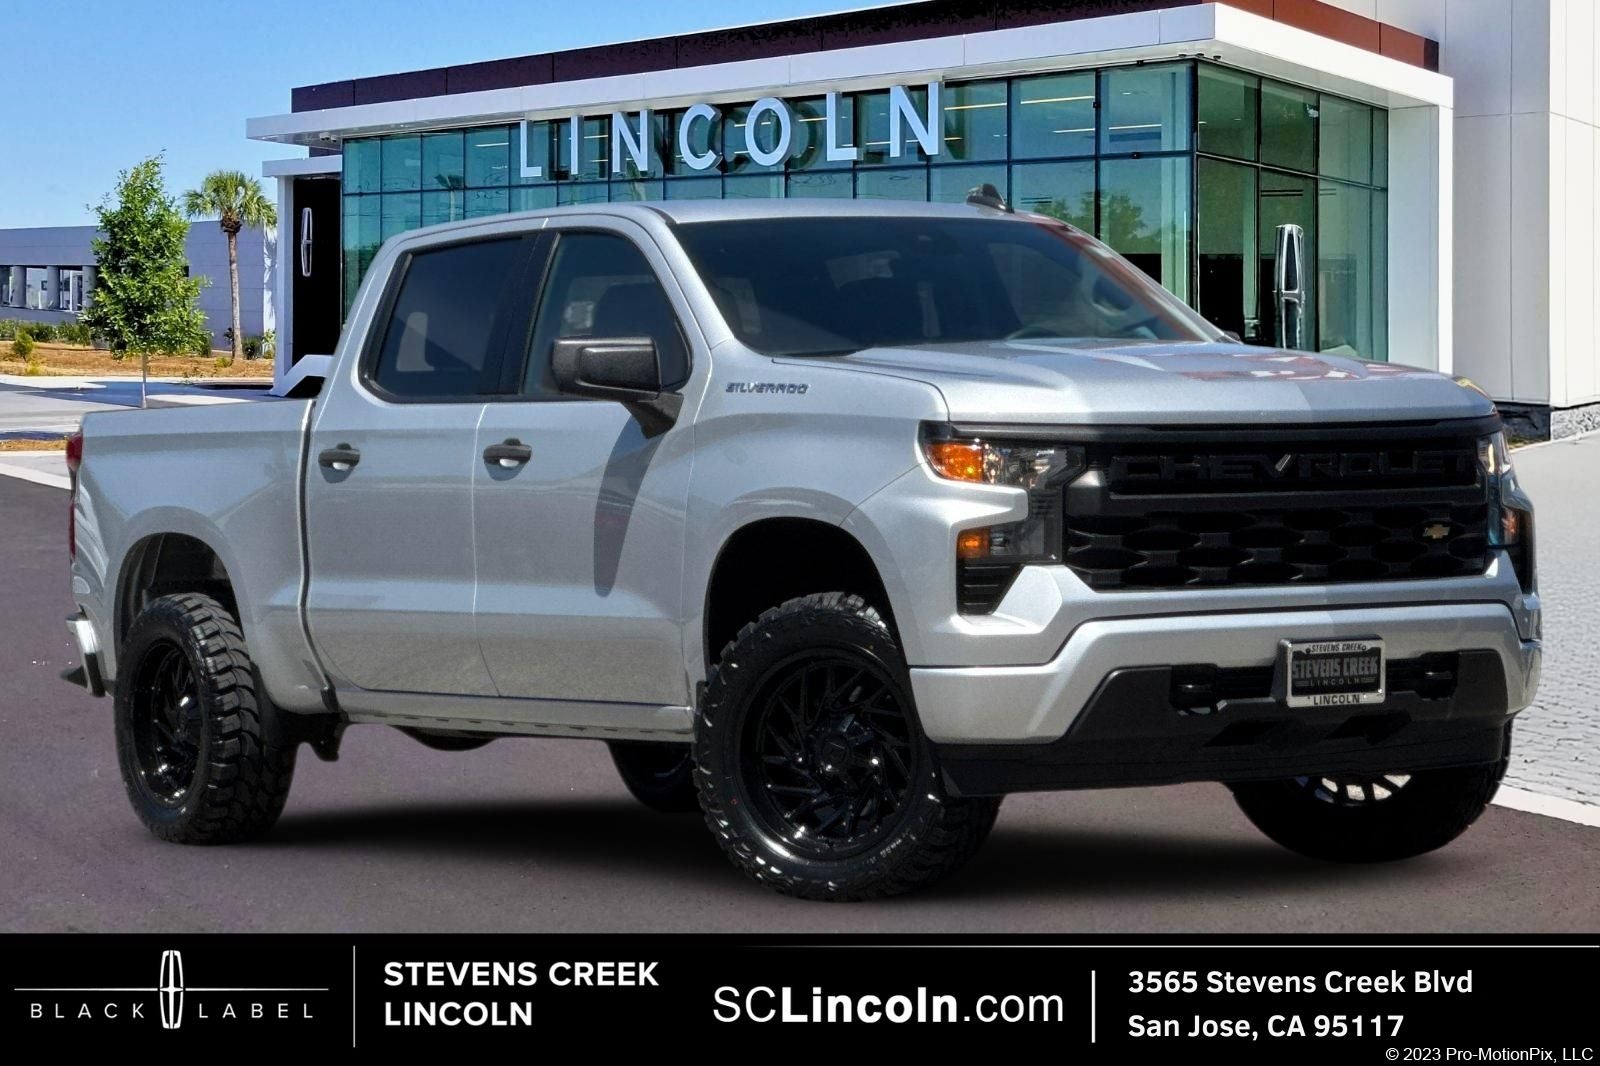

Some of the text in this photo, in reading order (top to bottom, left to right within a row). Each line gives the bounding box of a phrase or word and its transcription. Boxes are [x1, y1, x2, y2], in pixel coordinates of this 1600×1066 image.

[519, 81, 943, 178] LINCOLN
[1110, 449, 1476, 481] CHEVROLET
[1311, 643, 1362, 653] STEVENS CREEK
[1292, 655, 1378, 679] STEVENS CREEK
[1313, 694, 1361, 705] LINCOLN
